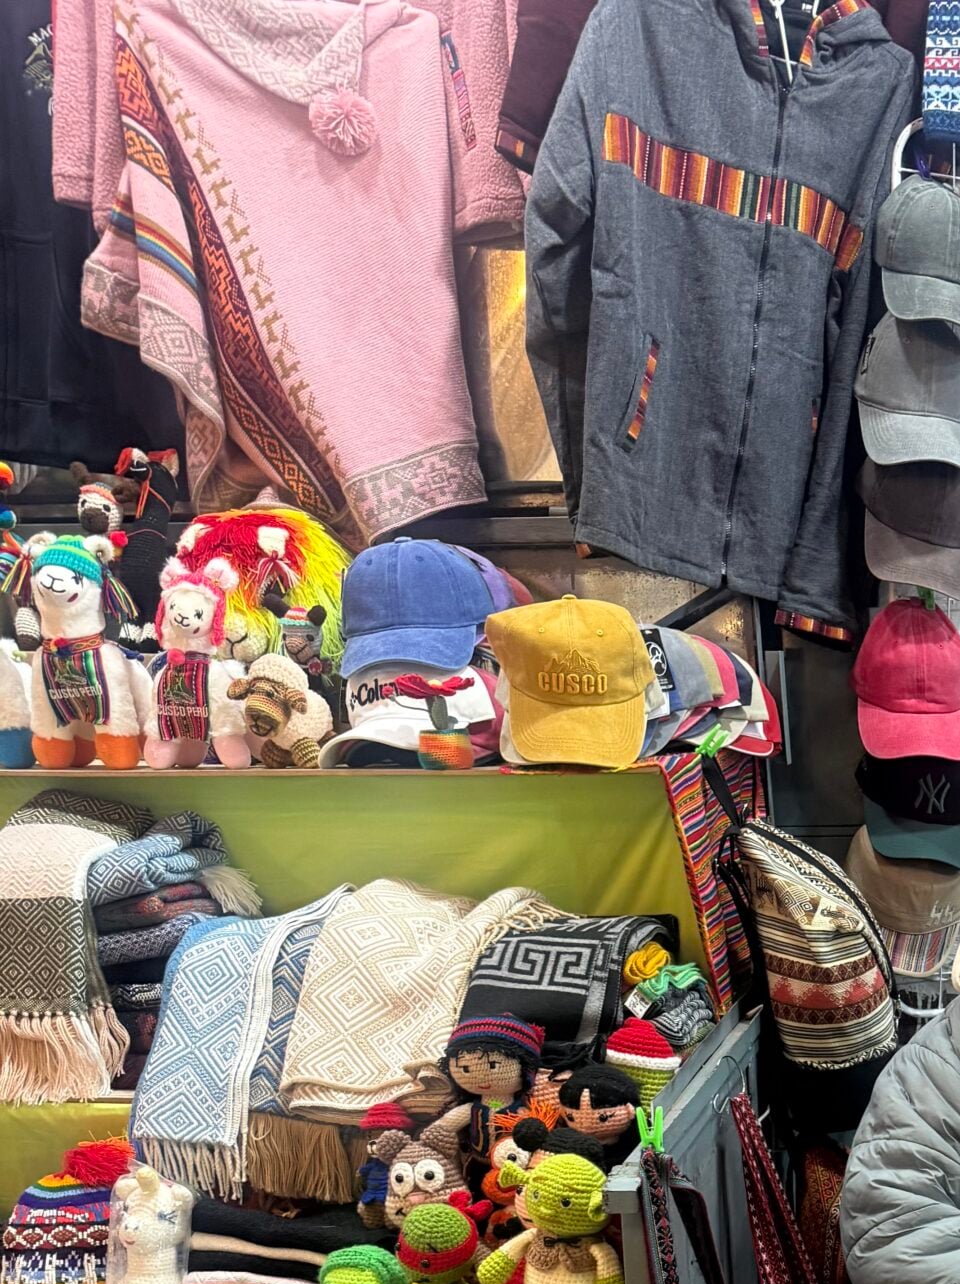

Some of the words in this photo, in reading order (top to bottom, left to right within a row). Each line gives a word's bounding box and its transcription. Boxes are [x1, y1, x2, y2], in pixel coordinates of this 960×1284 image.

[538, 671, 608, 695] CUSCO
[49, 688, 80, 700] CUSCO
[157, 704, 185, 717] CUSCO
[914, 772, 951, 815] NY
